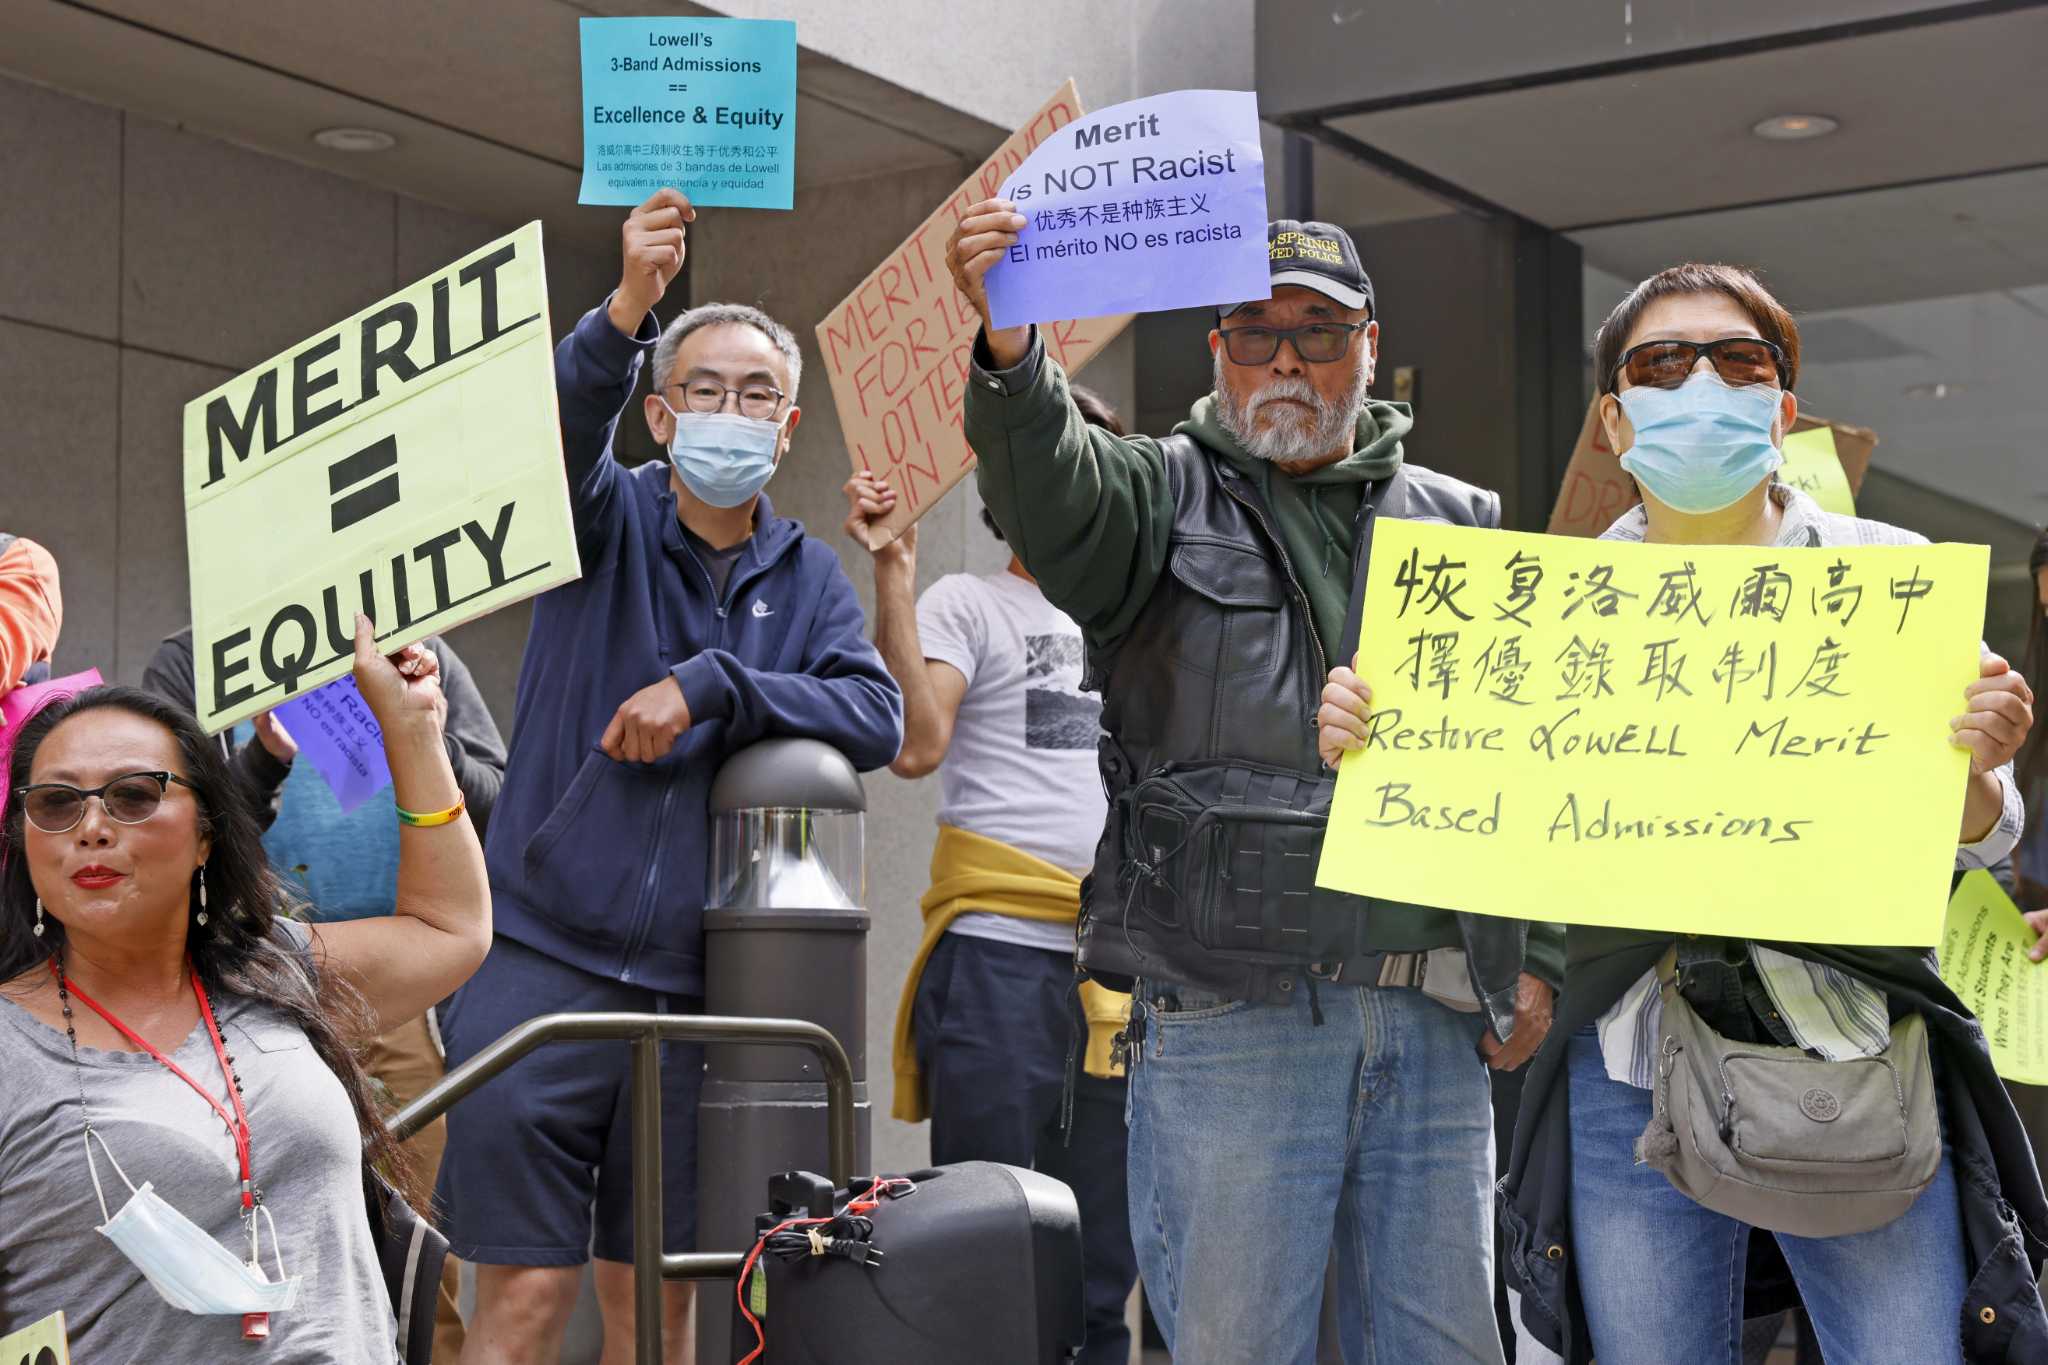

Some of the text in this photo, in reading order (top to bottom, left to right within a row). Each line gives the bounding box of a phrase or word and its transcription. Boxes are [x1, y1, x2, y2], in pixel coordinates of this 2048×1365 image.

[649, 32, 713, 47] Lowell's
[610, 56, 762, 73] 3-Band Admissions
[593, 106, 784, 130] Excellence & Equity
[1074, 113, 1161, 150] Merit
[596, 161, 780, 174] Las admisiones de 3 bandas de Lowell
[711, 179, 718, 190] y
[720, 178, 764, 190] equidad
[1043, 159, 1120, 196] NOT
[1132, 147, 1237, 184] Racist
[1034, 192, 1211, 232] 优秀不是种族主义
[1009, 222, 1242, 263] El mérito NO es racista
[1276, 231, 1341, 254] SPRINGS
[1298, 247, 1343, 265] POLICE
[826, 224, 935, 375] MERIT
[204, 240, 517, 484] MERIT
[853, 316, 940, 418] FOR
[897, 440, 940, 513] IN
[211, 500, 518, 715] EQUITY
[1366, 707, 1506, 755] Restore
[1736, 716, 1890, 758] Merit
[1366, 781, 1813, 844] Based Admissions
[1974, 930, 1998, 998] Students
[1994, 940, 2015, 1049] Where They Are
